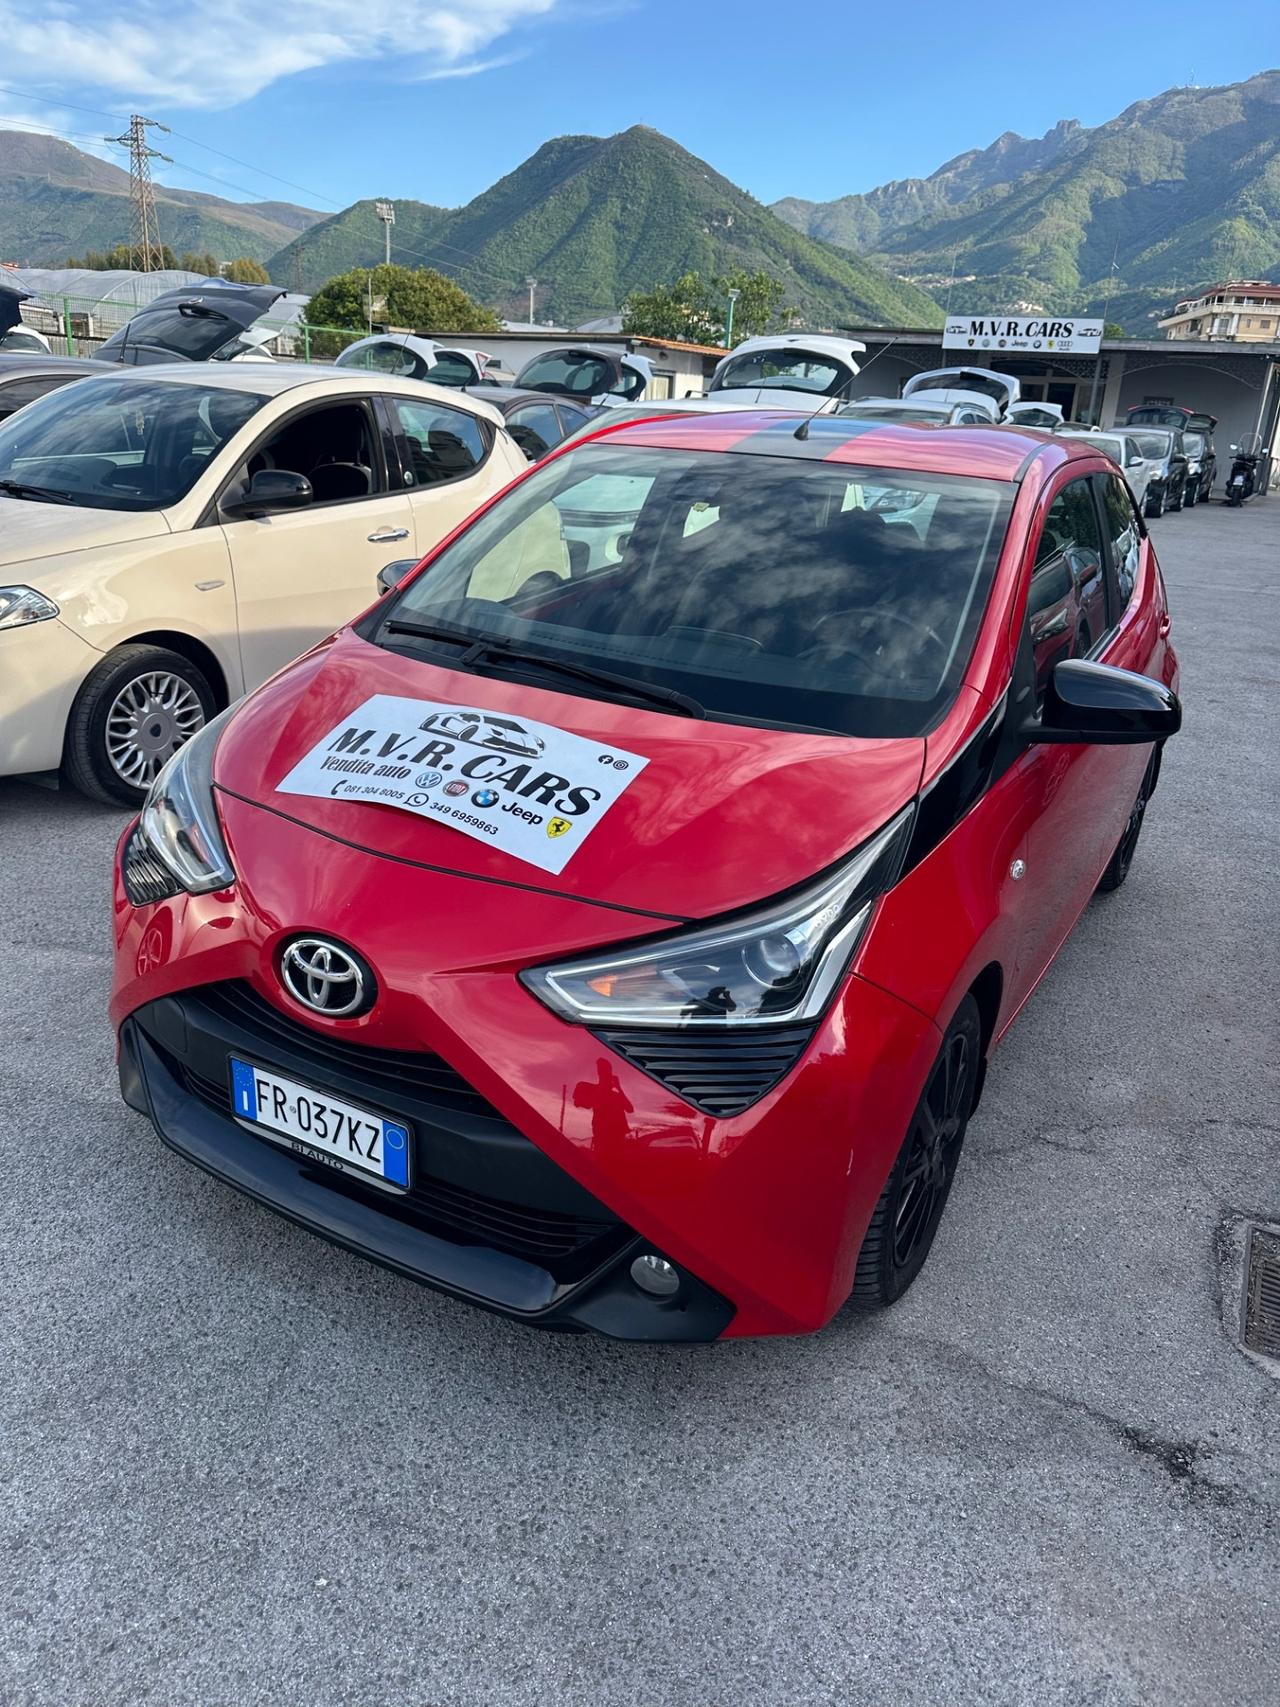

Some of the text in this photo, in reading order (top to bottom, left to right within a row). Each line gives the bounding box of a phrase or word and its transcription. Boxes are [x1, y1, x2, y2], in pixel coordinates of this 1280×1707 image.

[969, 320, 1074, 338] M.V.R.CARS
[320, 756, 411, 779] Vendita auto
[327, 727, 601, 816] M.V.R.CARS
[344, 786, 405, 799] 081 304 8005
[429, 802, 499, 836] 349 6959863
[501, 802, 544, 826] Jeep
